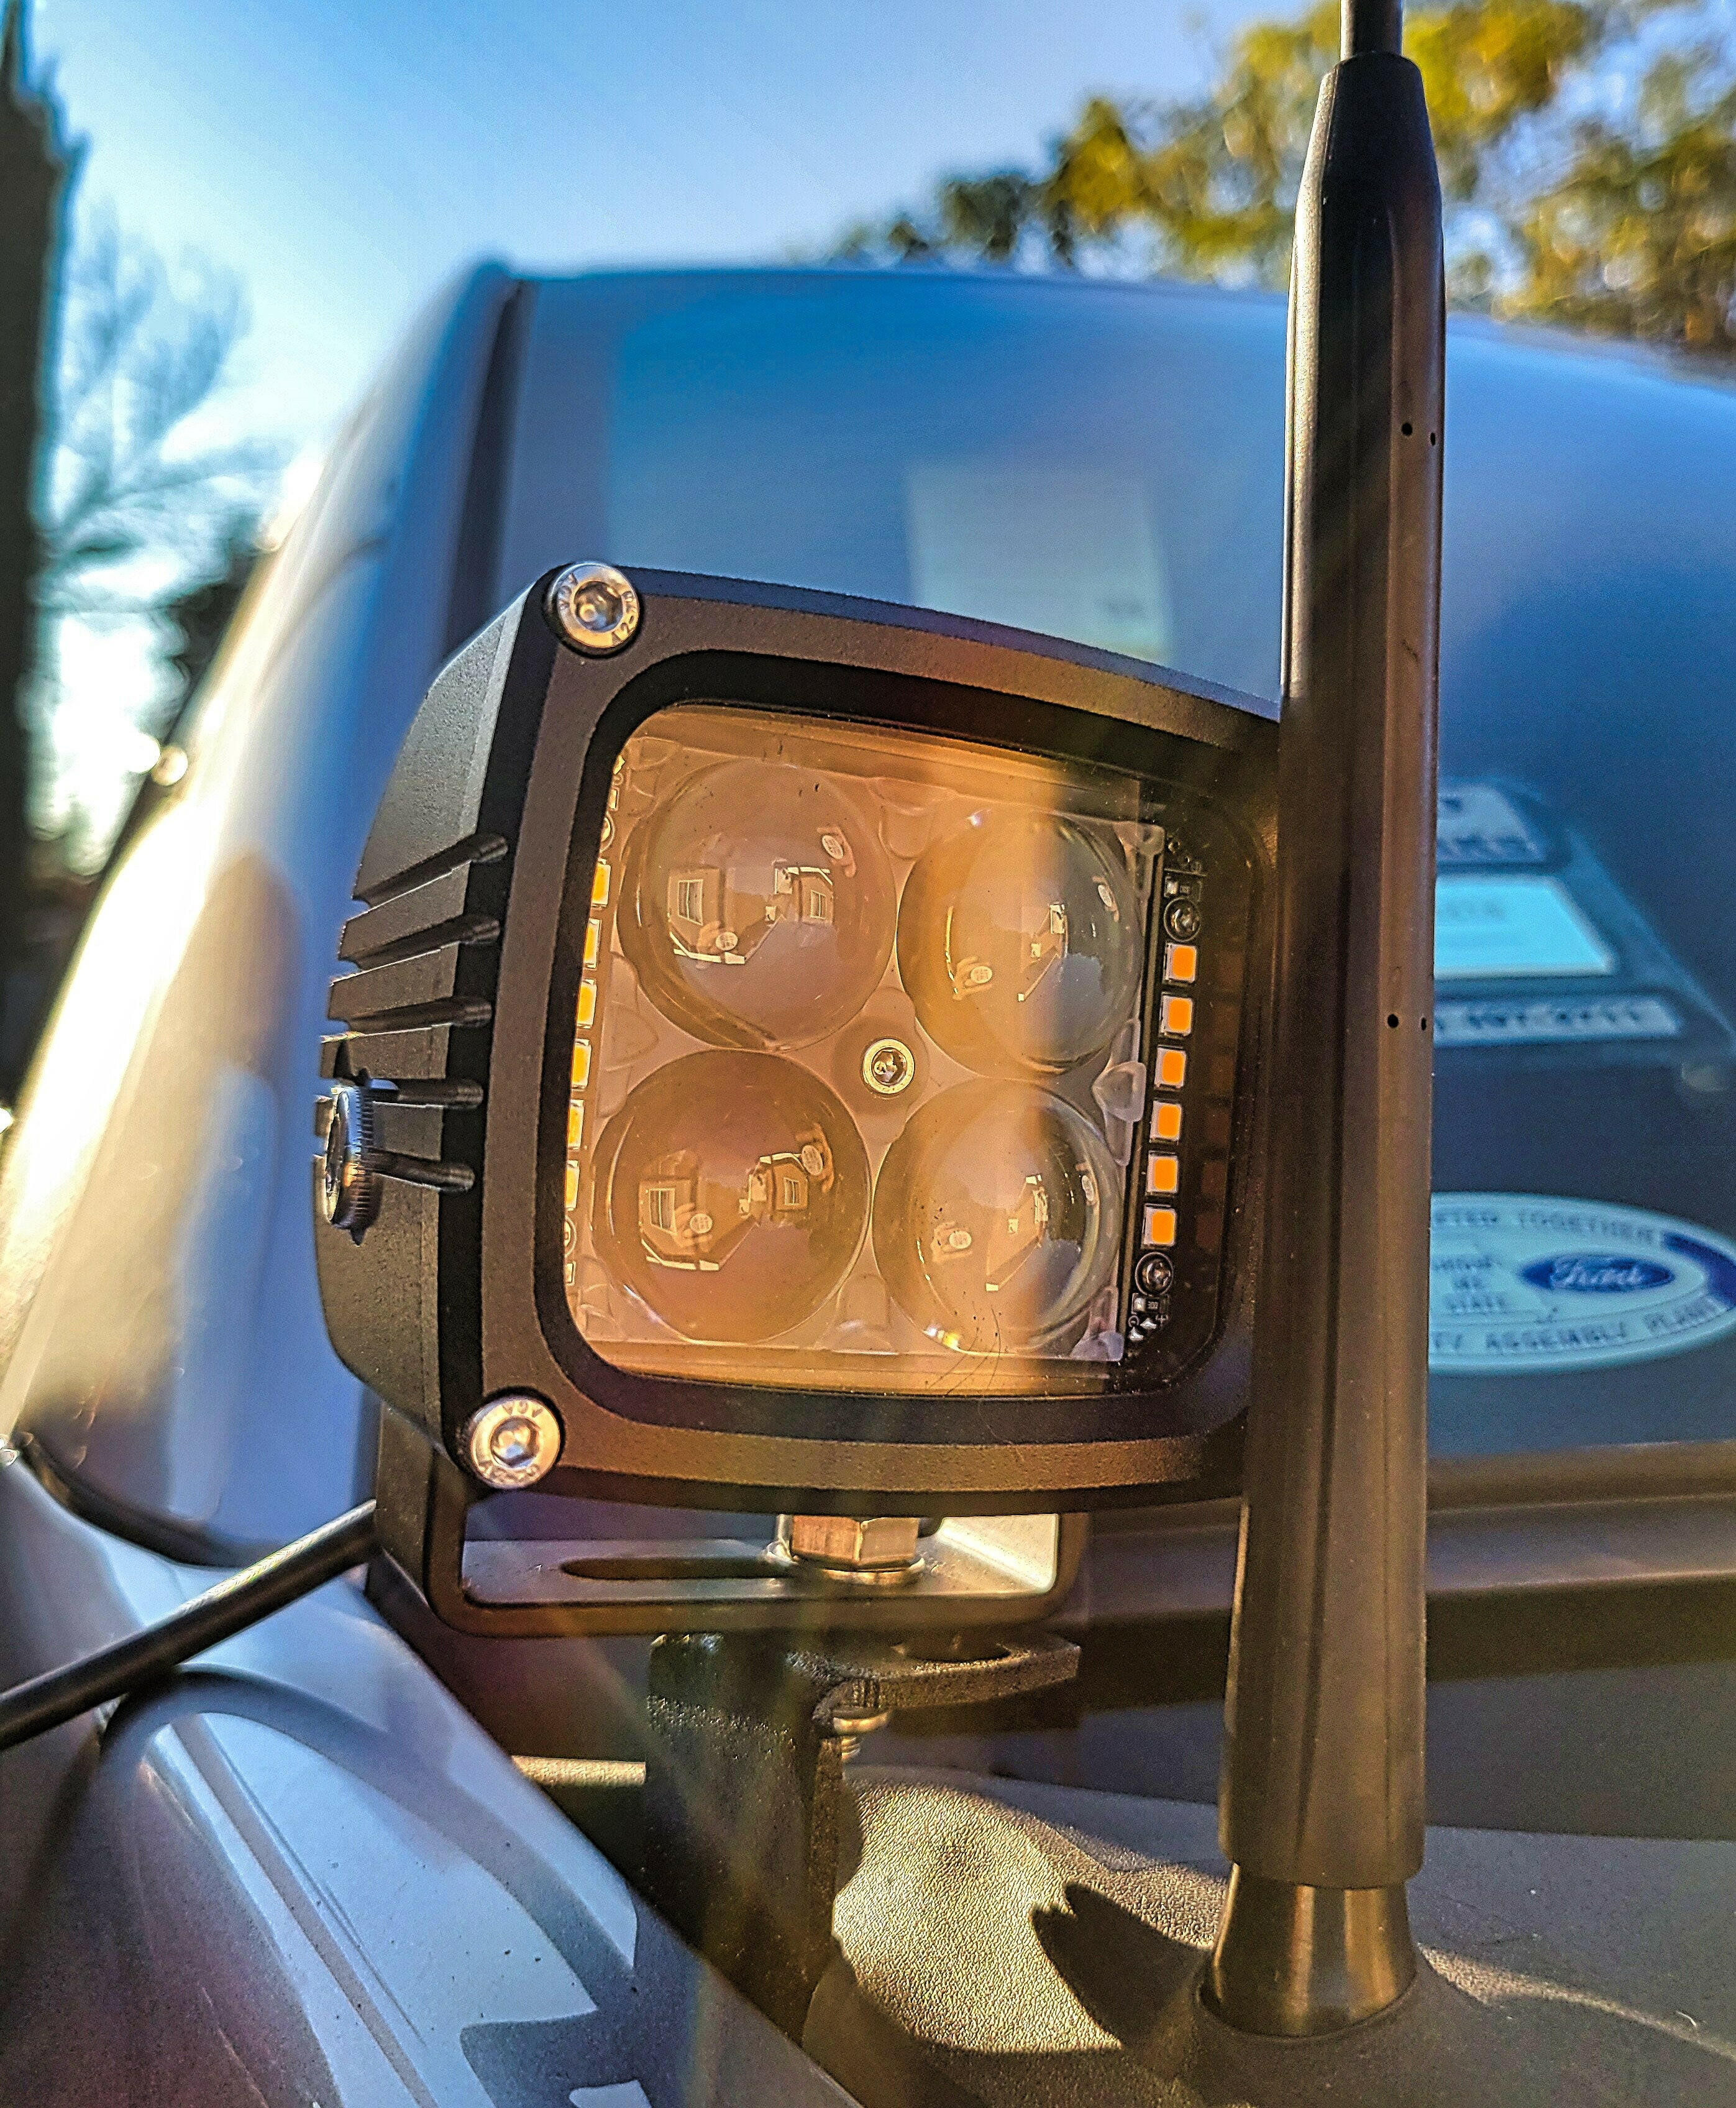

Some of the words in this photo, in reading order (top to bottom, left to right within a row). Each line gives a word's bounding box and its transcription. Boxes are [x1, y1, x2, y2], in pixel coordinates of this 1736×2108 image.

[1518, 1209, 1656, 1244] TOGETHER
[1551, 1254, 1645, 1289] Ford
[1485, 1321, 1627, 1351] ASSEMBLY
